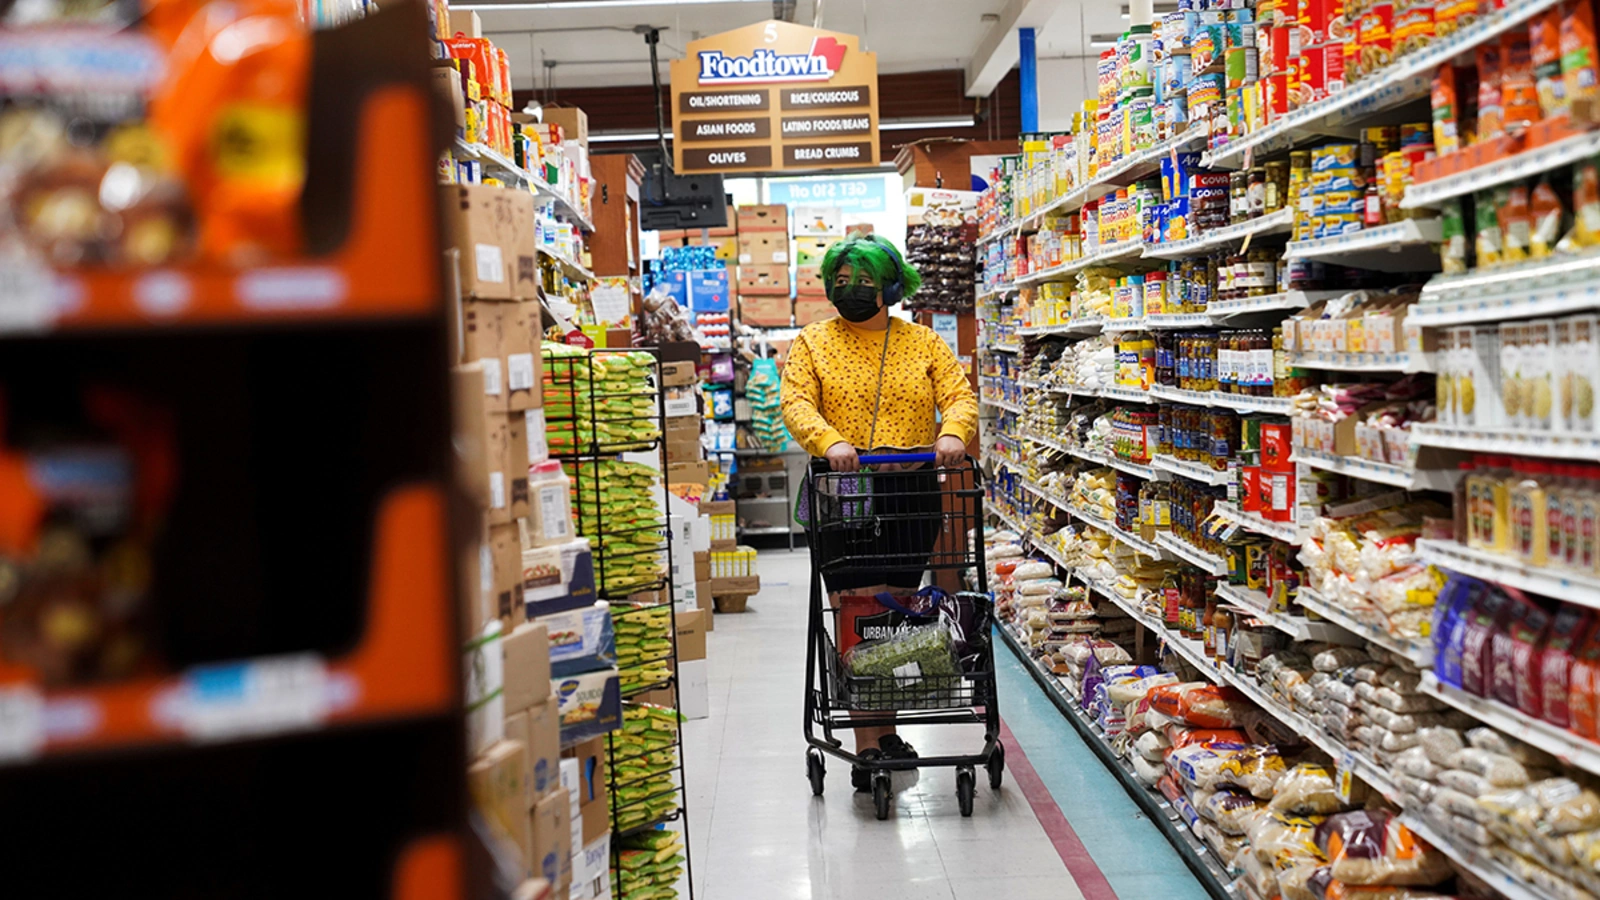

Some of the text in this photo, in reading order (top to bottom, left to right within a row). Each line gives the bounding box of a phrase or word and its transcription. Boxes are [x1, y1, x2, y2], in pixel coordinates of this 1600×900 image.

[764, 23, 778, 43] 5
[700, 50, 829, 77] Foodtown
[689, 94, 761, 107] OIL/SHORTENING
[790, 91, 859, 104] RICE/COUSCOUS
[696, 123, 756, 135] ASIAN FOODS
[782, 118, 869, 132] LATINO FOODS/BEANS
[708, 152, 747, 163] OLIVES
[794, 147, 859, 160] BREAD CRUMBS
[1201, 175, 1228, 184] GOYA
[863, 626, 893, 640] URBAN
